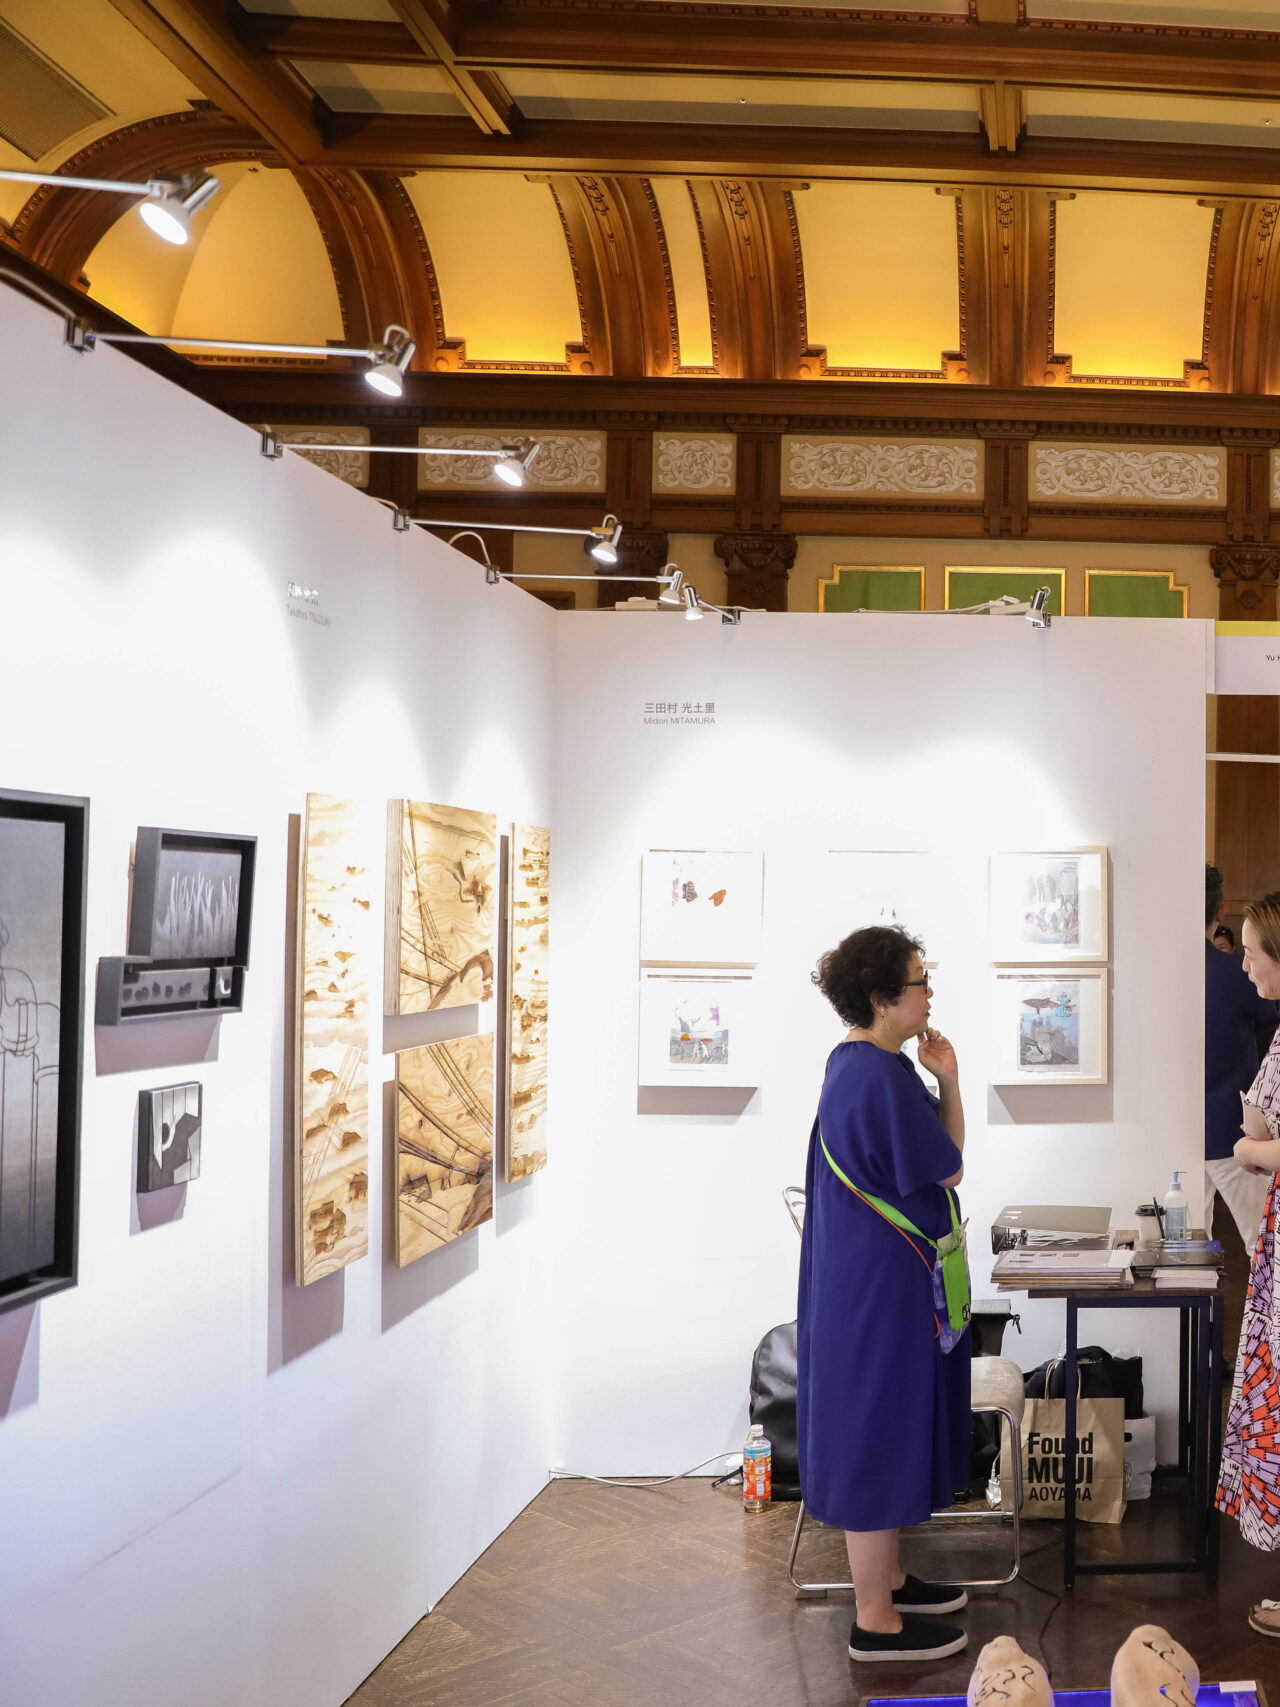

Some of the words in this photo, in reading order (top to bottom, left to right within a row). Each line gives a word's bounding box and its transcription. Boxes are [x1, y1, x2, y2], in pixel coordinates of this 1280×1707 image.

[644, 702, 678, 714] 三田村
[681, 702, 715, 714] 光土里
[643, 717, 668, 725] Midori
[670, 717, 716, 725] MITAMURA
